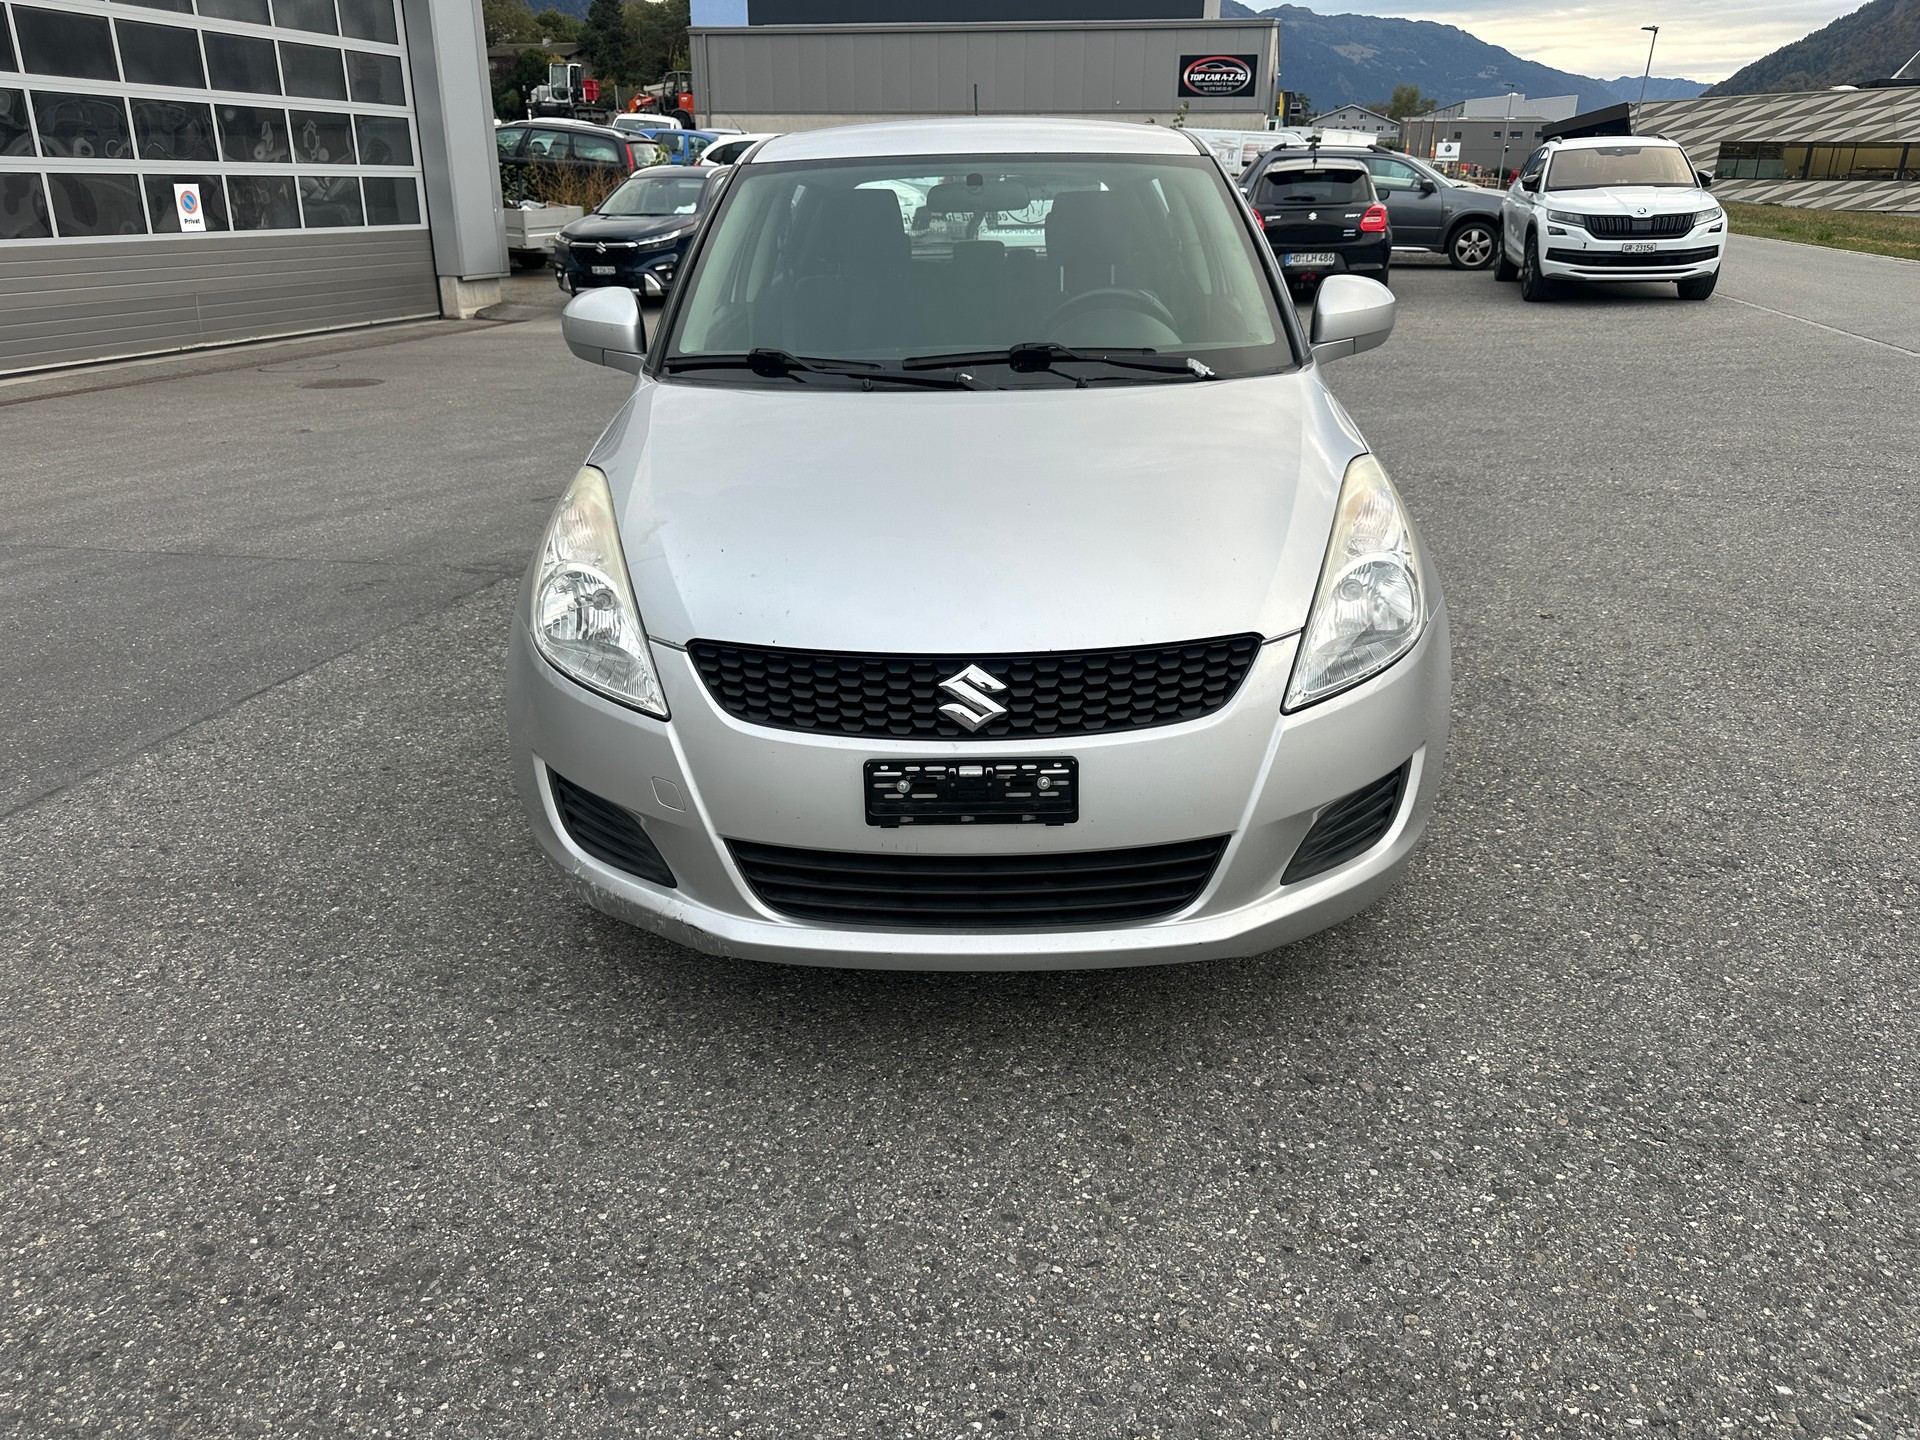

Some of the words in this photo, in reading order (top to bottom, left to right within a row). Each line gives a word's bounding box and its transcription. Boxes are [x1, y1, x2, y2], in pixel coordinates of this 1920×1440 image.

[1190, 73, 1204, 81] TOP
[1205, 73, 1220, 81] CAR
[1221, 73, 1235, 81] A-Z
[1235, 73, 1246, 81] AG
[1624, 244, 1633, 252] GR
[1635, 244, 1654, 252] 23156
[1291, 254, 1301, 263] HD
[1305, 254, 1317, 263] LH
[1319, 253, 1334, 263] 486
